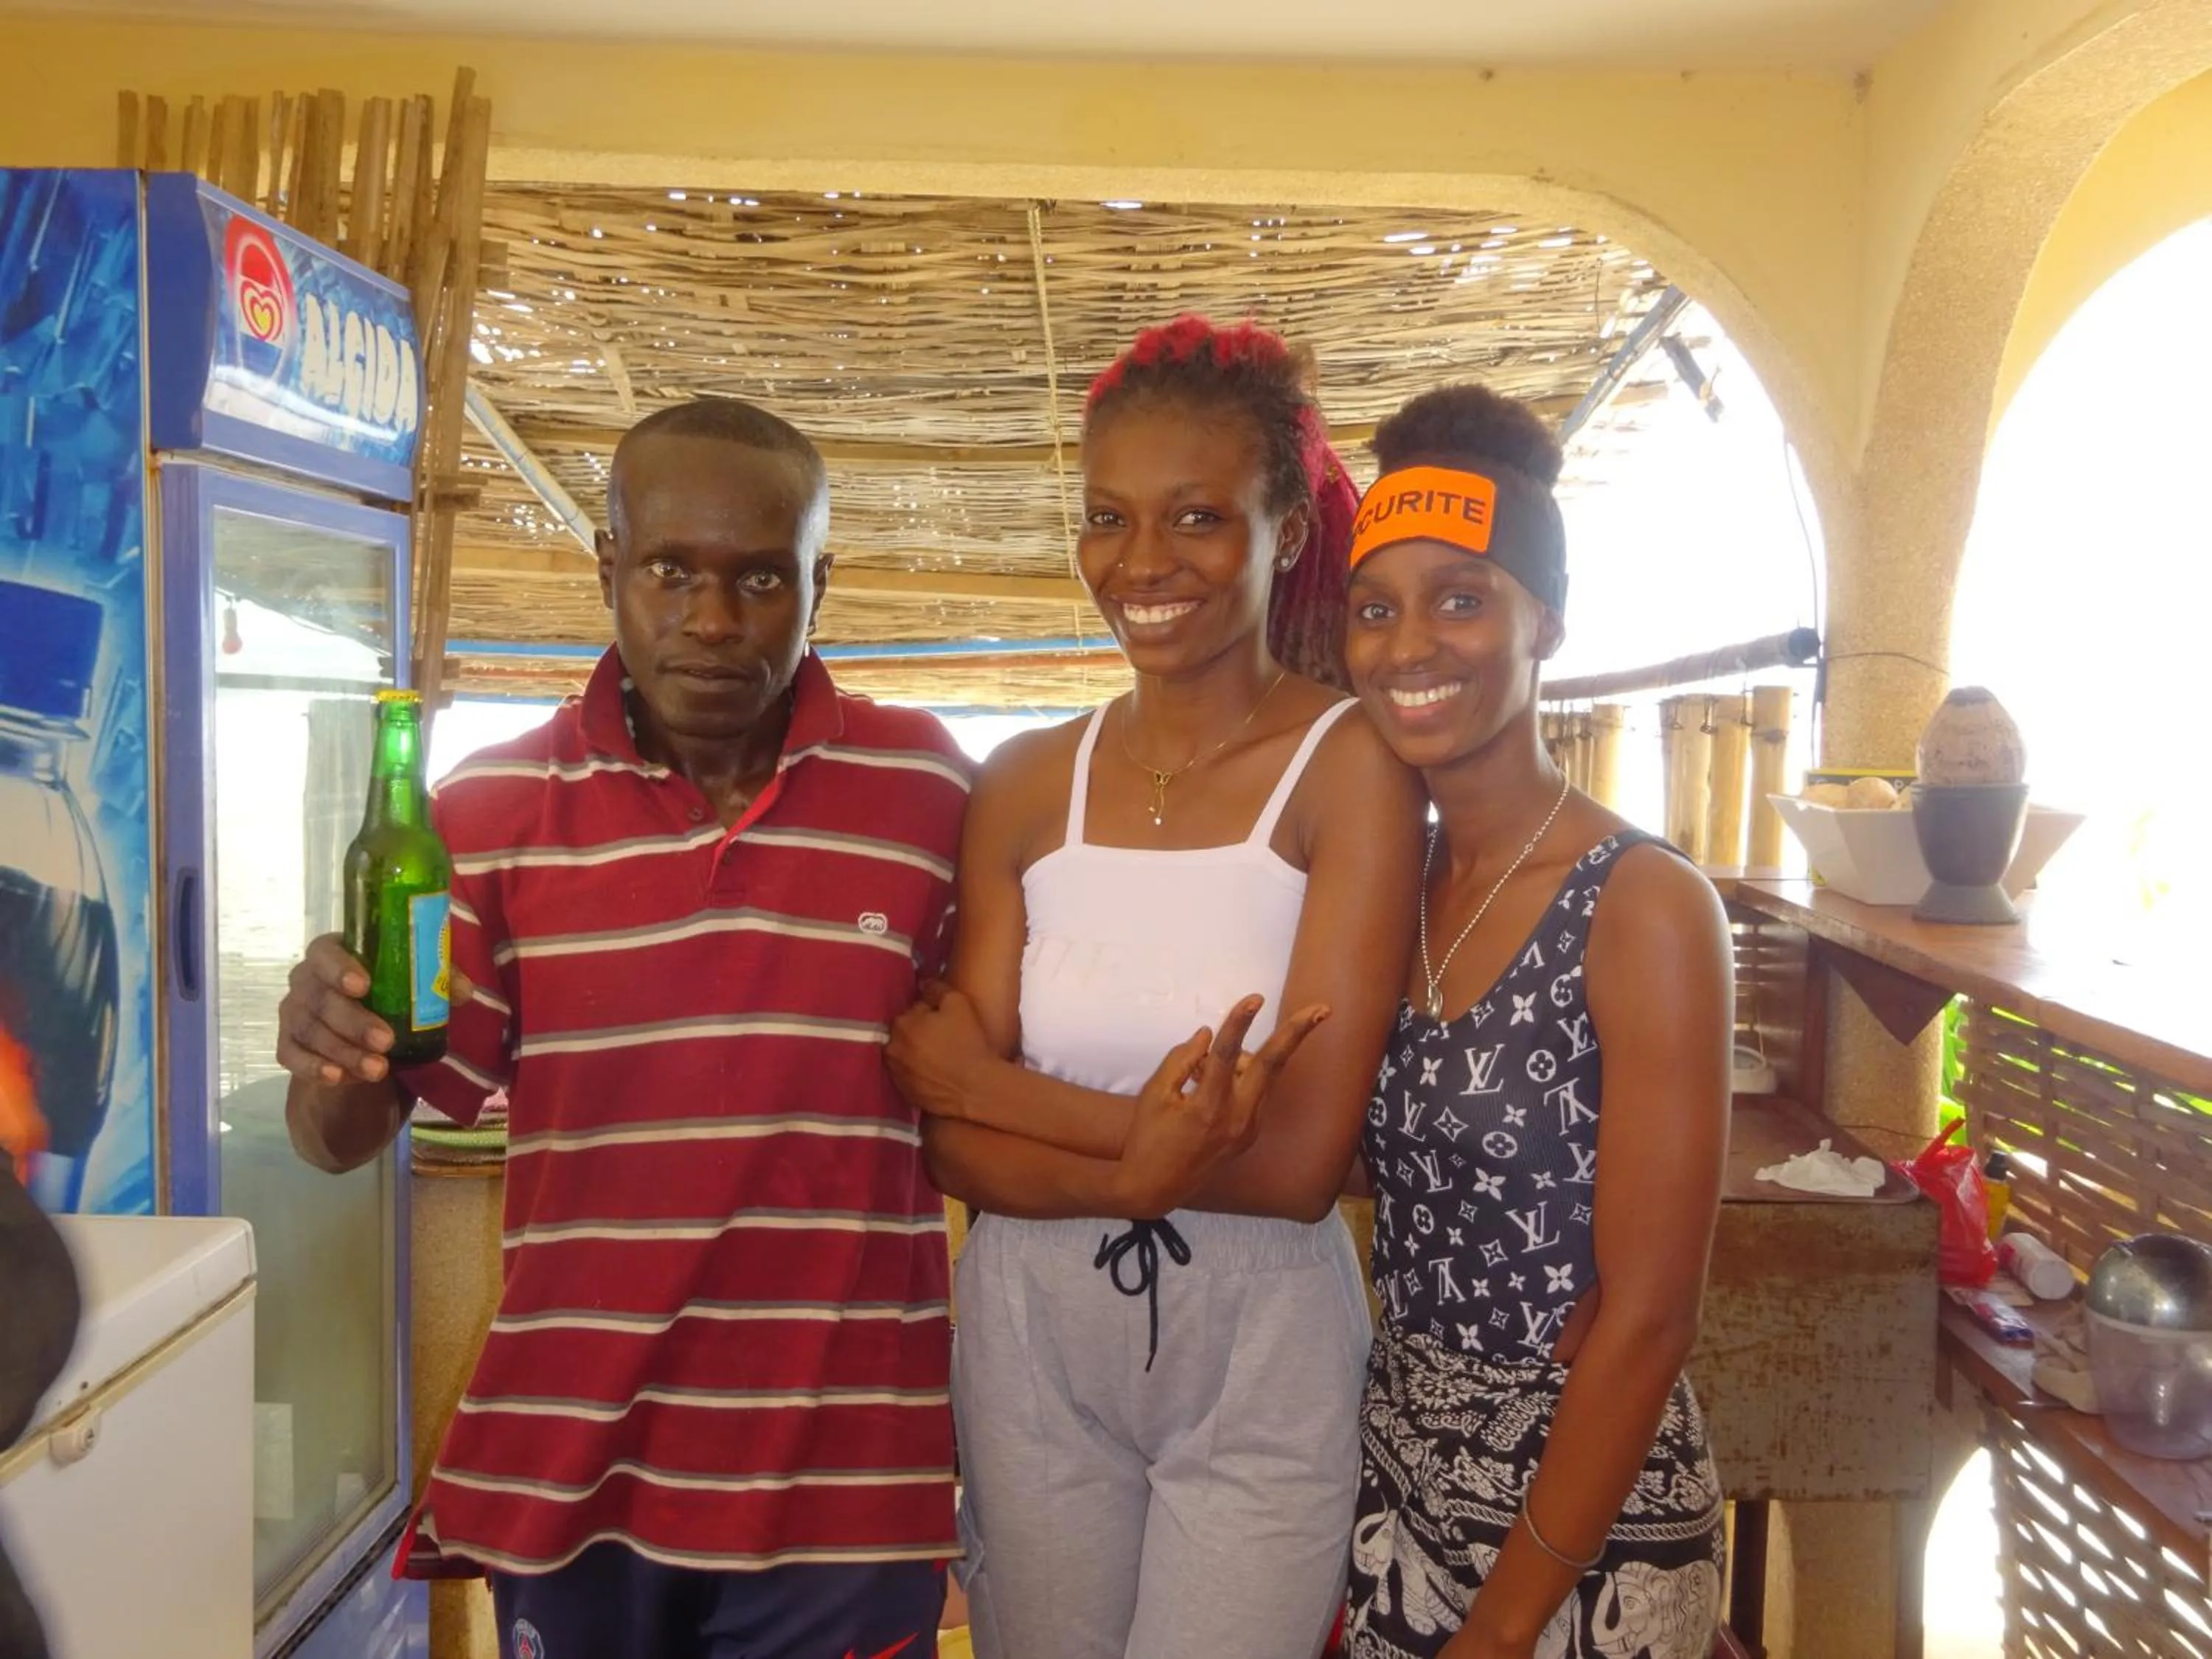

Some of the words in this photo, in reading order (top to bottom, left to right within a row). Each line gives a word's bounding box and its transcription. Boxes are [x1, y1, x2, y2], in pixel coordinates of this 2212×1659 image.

[300, 292, 418, 434] ALGIDA
[1458, 1043, 1506, 1096] LV
[1398, 1089, 1427, 1142] LV
[1409, 1150, 1453, 1194] LV
[1504, 1200, 1561, 1253] LV
